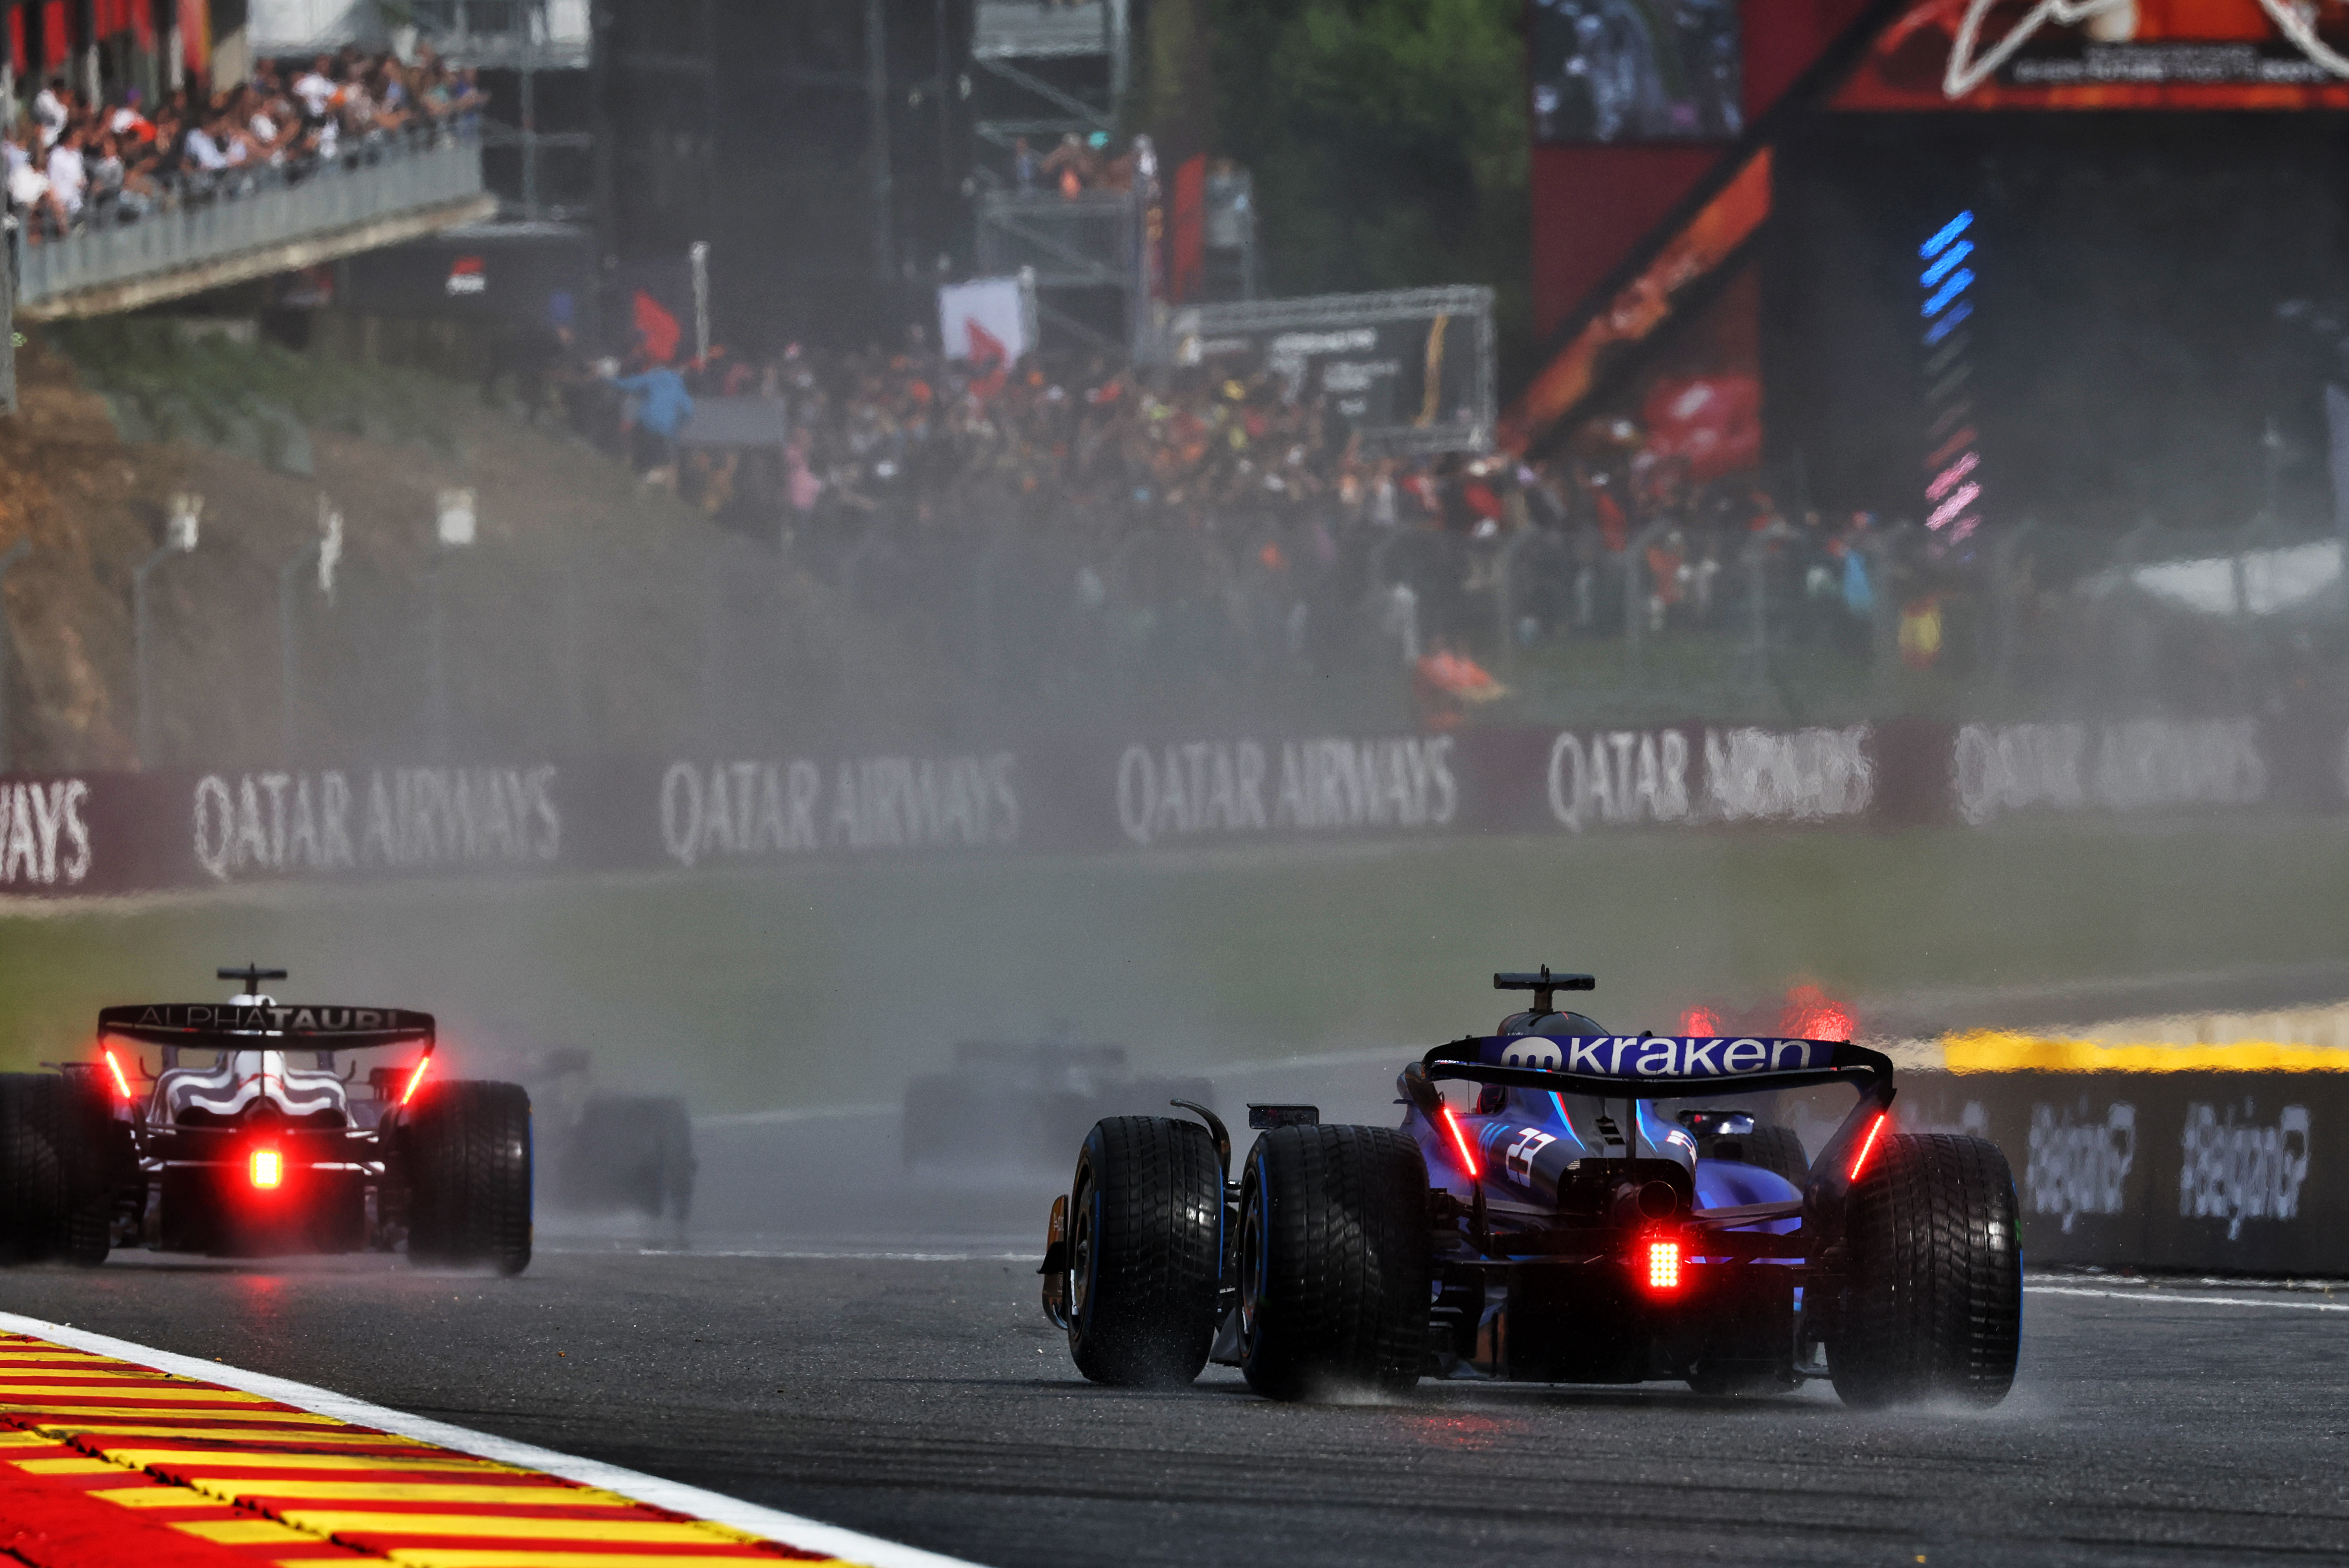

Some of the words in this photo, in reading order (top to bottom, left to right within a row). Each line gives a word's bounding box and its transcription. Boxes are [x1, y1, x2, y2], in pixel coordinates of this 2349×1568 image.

[193, 770, 353, 880] QATAR
[661, 760, 818, 866] QATAR
[1116, 739, 1267, 845] QATAR
[1276, 735, 1457, 827] AIRWAYS
[1548, 729, 1688, 833] QATAR
[140, 1006, 397, 1029] ALPHATAURI
[1505, 1127, 1558, 1188] 23
